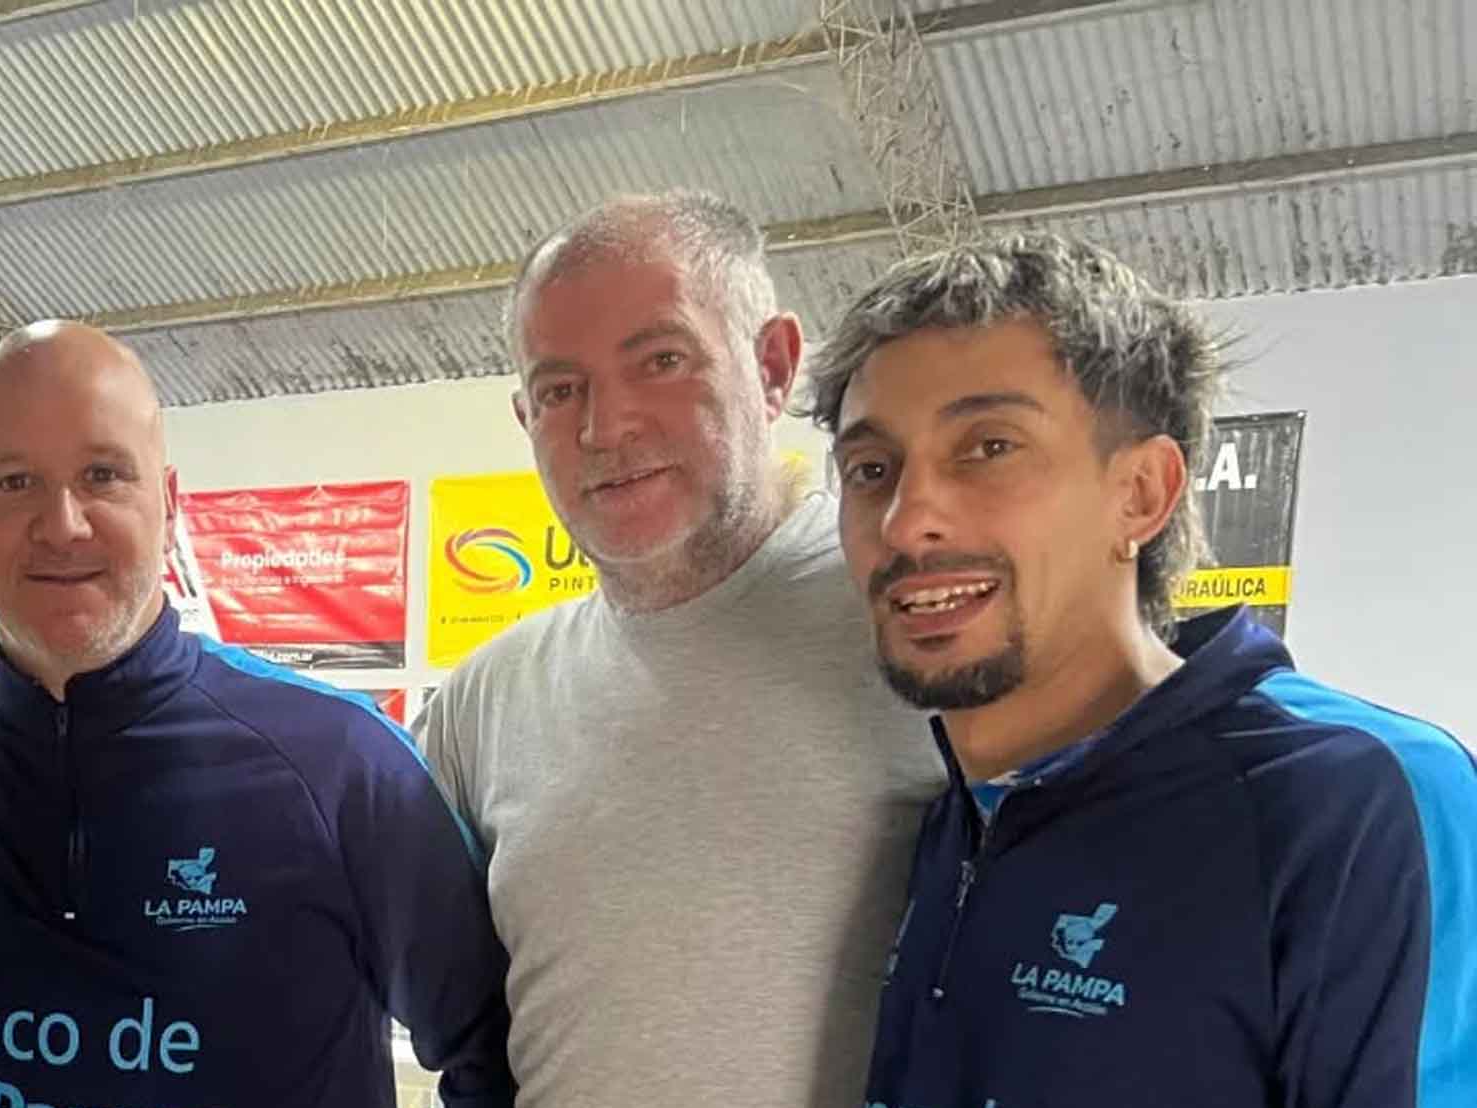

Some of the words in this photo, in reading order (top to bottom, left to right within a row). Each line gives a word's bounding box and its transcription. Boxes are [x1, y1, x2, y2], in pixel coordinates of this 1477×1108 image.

[1195, 442, 1257, 490] .A.
[1181, 575, 1266, 598] RAÚLICA
[145, 899, 171, 915] LA
[177, 898, 247, 915] PAMPA
[1011, 962, 1038, 987] LA
[1042, 968, 1124, 1006] PAMPA
[109, 998, 200, 1073] de
